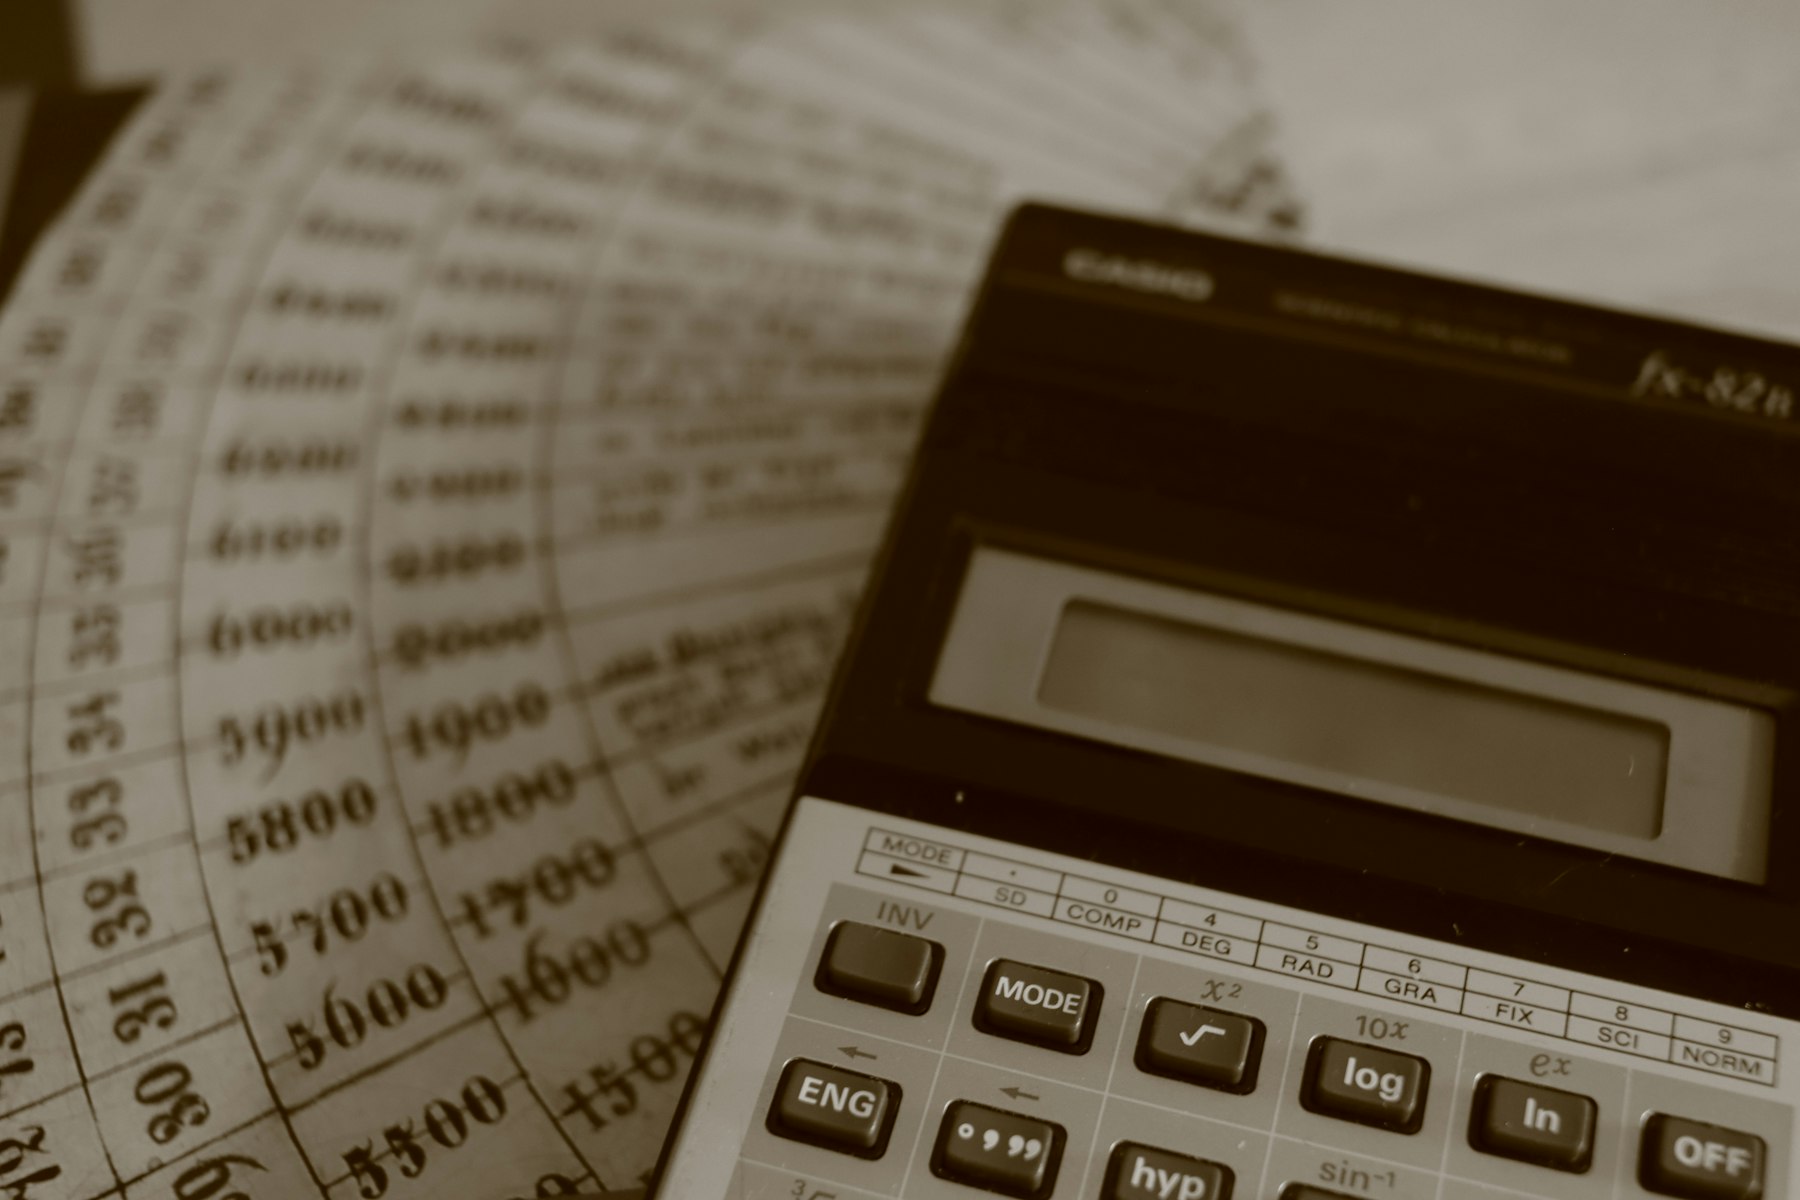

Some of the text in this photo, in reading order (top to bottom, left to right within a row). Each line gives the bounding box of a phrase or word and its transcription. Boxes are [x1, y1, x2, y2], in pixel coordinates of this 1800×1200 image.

[64, 690, 126, 757] 34
[216, 687, 366, 786] 5900
[404, 680, 550, 772] 1900
[66, 776, 128, 853] 33
[224, 777, 378, 867] 5800
[425, 758, 577, 851] 1800
[881, 836, 951, 865] MODE
[457, 837, 618, 940] 1700
[994, 886, 1027, 907] SD
[82, 867, 152, 951] 32
[250, 870, 410, 978] 5700
[877, 901, 936, 931] INV
[1066, 903, 1142, 933] COMP
[1203, 912, 1218, 928] 4
[1181, 931, 1232, 956] DEG
[1305, 936, 1319, 951] 5
[496, 925, 652, 1026] 1600
[1280, 954, 1334, 980] RAD
[1407, 959, 1422, 975] 6
[108, 969, 178, 1045] 31
[994, 976, 1081, 1015] MODE
[1384, 977, 1438, 1004] GRA
[1511, 982, 1526, 998] 7
[284, 962, 449, 1072] 5600
[1495, 1002, 1534, 1026] FIX
[1615, 1005, 1629, 1022] 8
[1597, 1026, 1640, 1050] SCI
[1717, 1028, 1732, 1044] 9
[553, 1011, 709, 1134] 1500
[1343, 1057, 1406, 1102] log
[1681, 1046, 1762, 1077] NORM
[134, 1060, 211, 1146] 30
[798, 1076, 876, 1118] ENG
[342, 1074, 508, 1200] 5500
[1674, 1136, 1749, 1174] OFF
[1131, 1156, 1206, 1200] hyp
